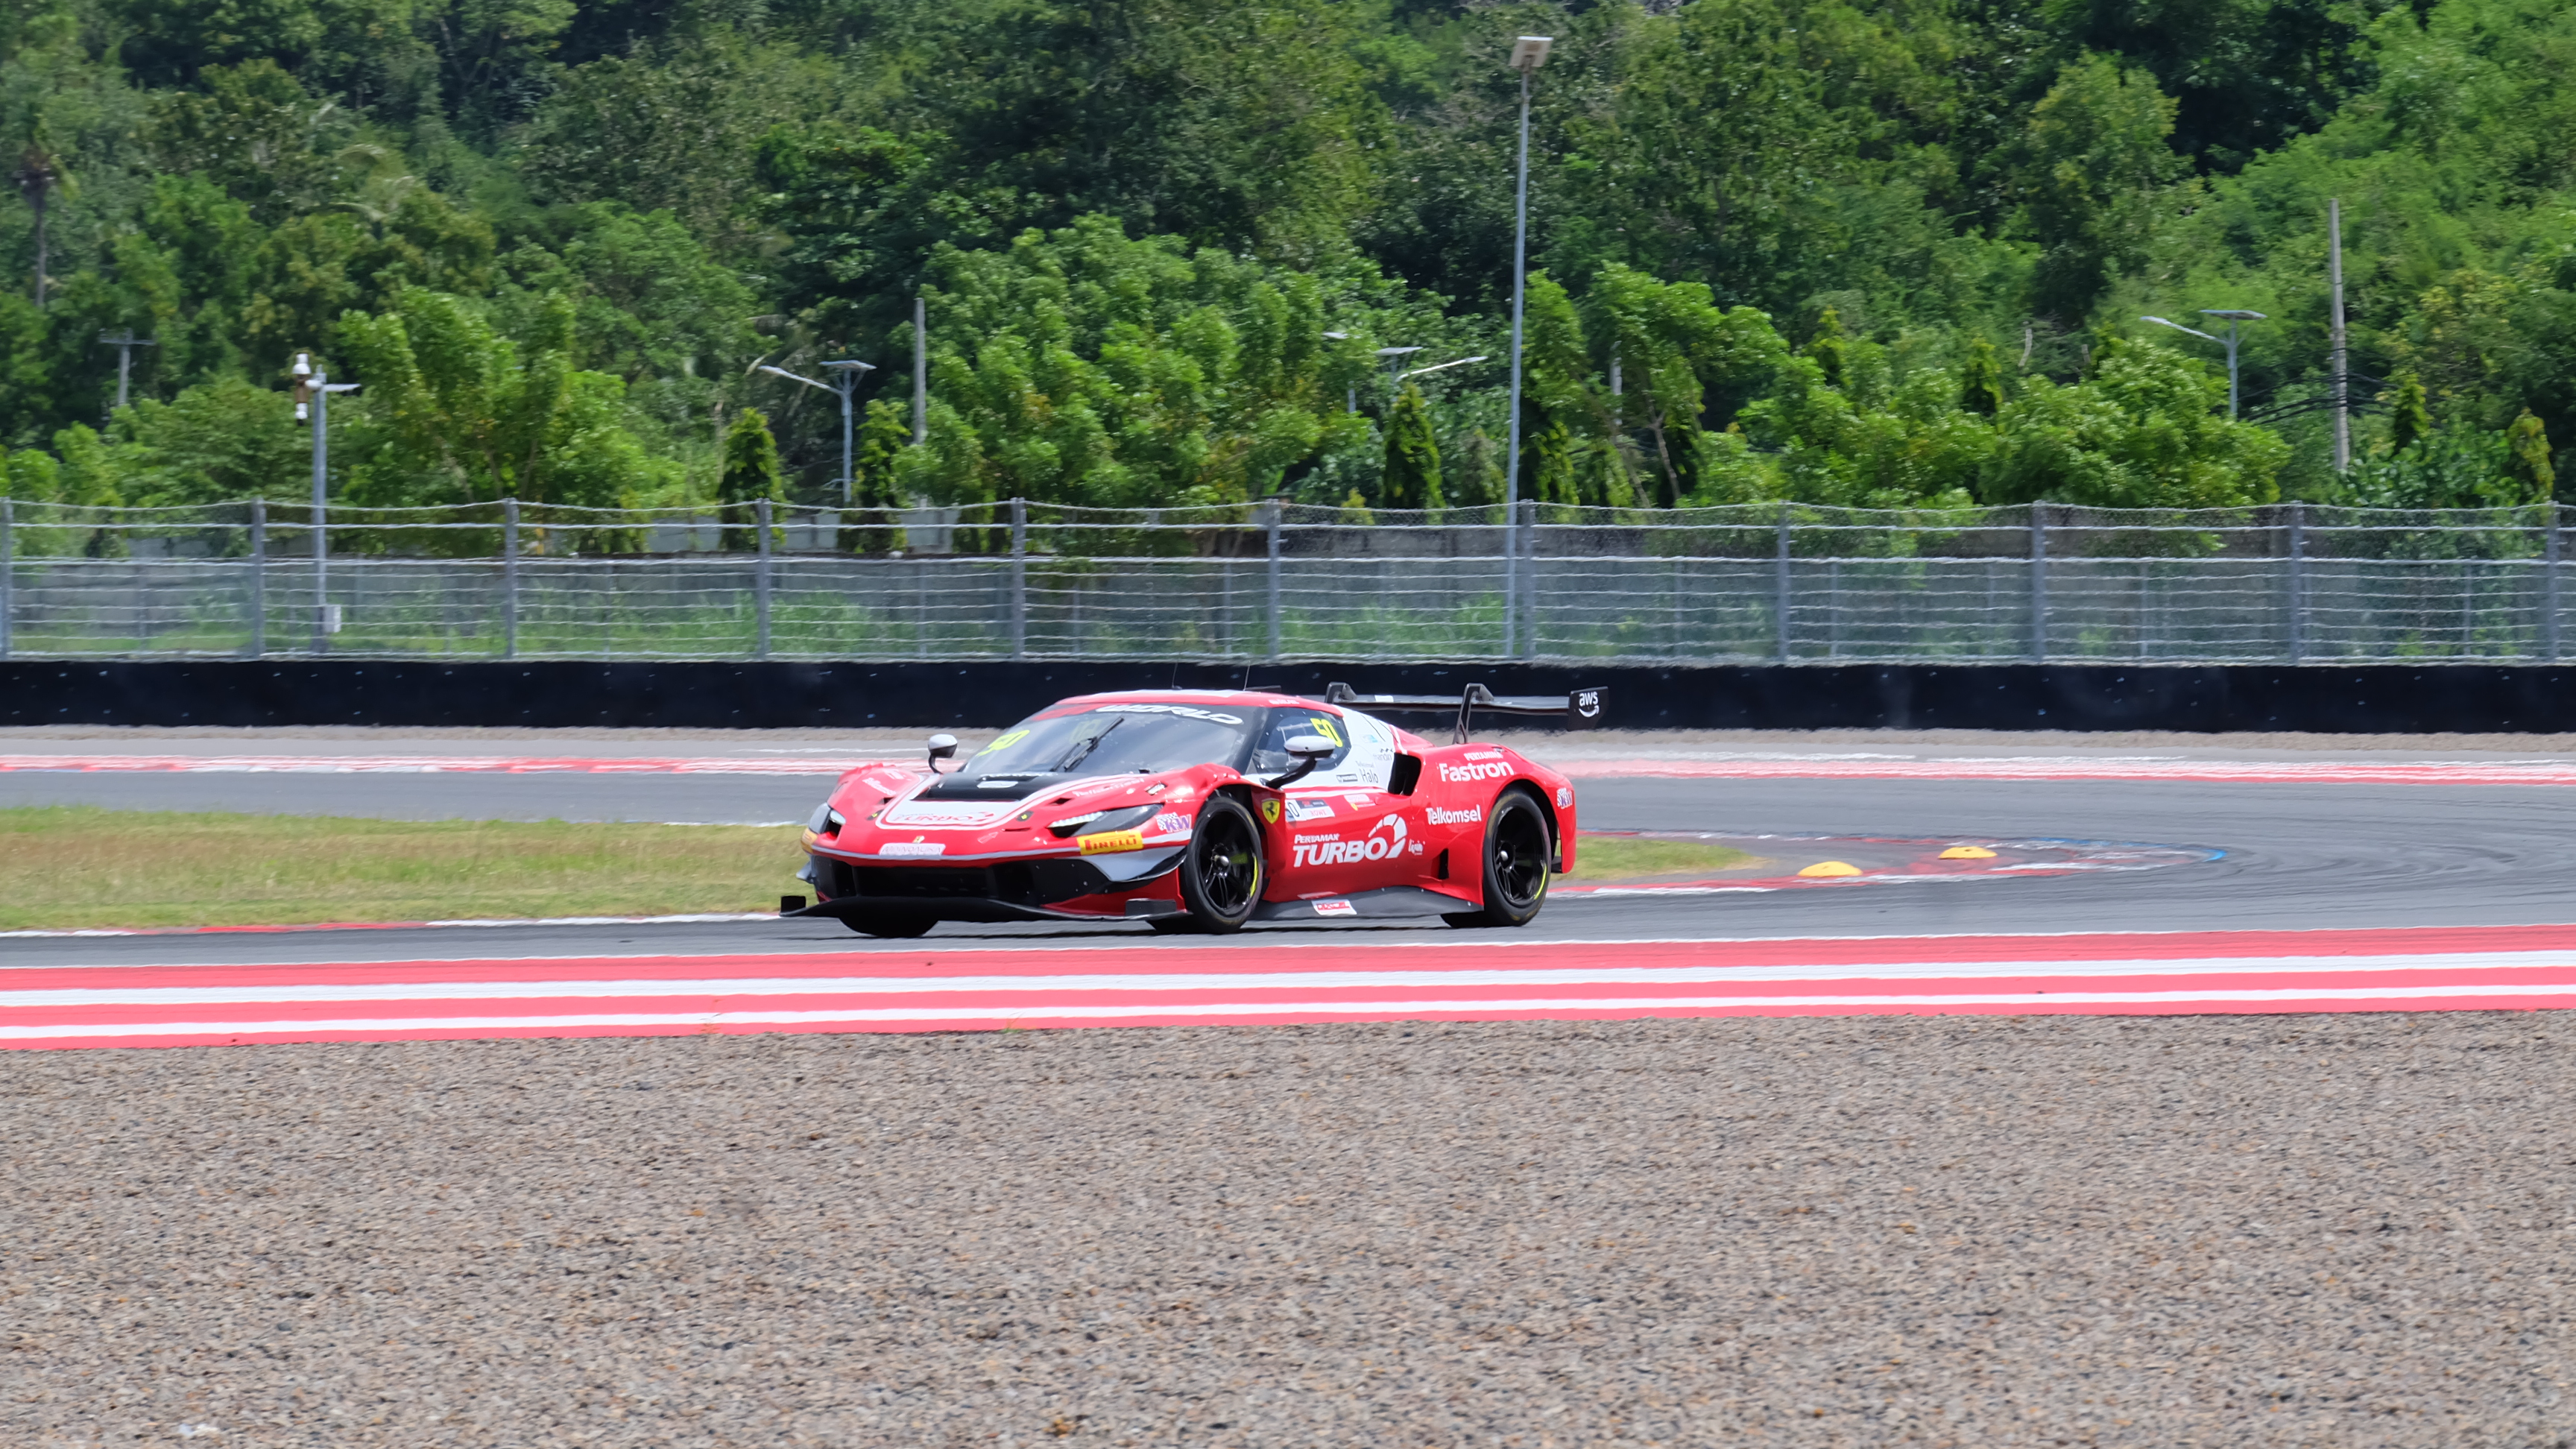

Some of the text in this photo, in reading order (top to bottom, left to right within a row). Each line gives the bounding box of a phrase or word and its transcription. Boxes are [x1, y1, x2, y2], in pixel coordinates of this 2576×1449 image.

[1579, 691, 1599, 707] aws
[1310, 718, 1343, 748] 50
[1359, 768, 1379, 783] Halo
[1439, 761, 1515, 782] Fastron
[1164, 814, 1192, 833] KW
[1426, 804, 1482, 825] Telkomsel
[1084, 835, 1137, 851] PIRELLI
[1294, 833, 1340, 844] PERTAMAX
[1292, 837, 1389, 868] TURBO
